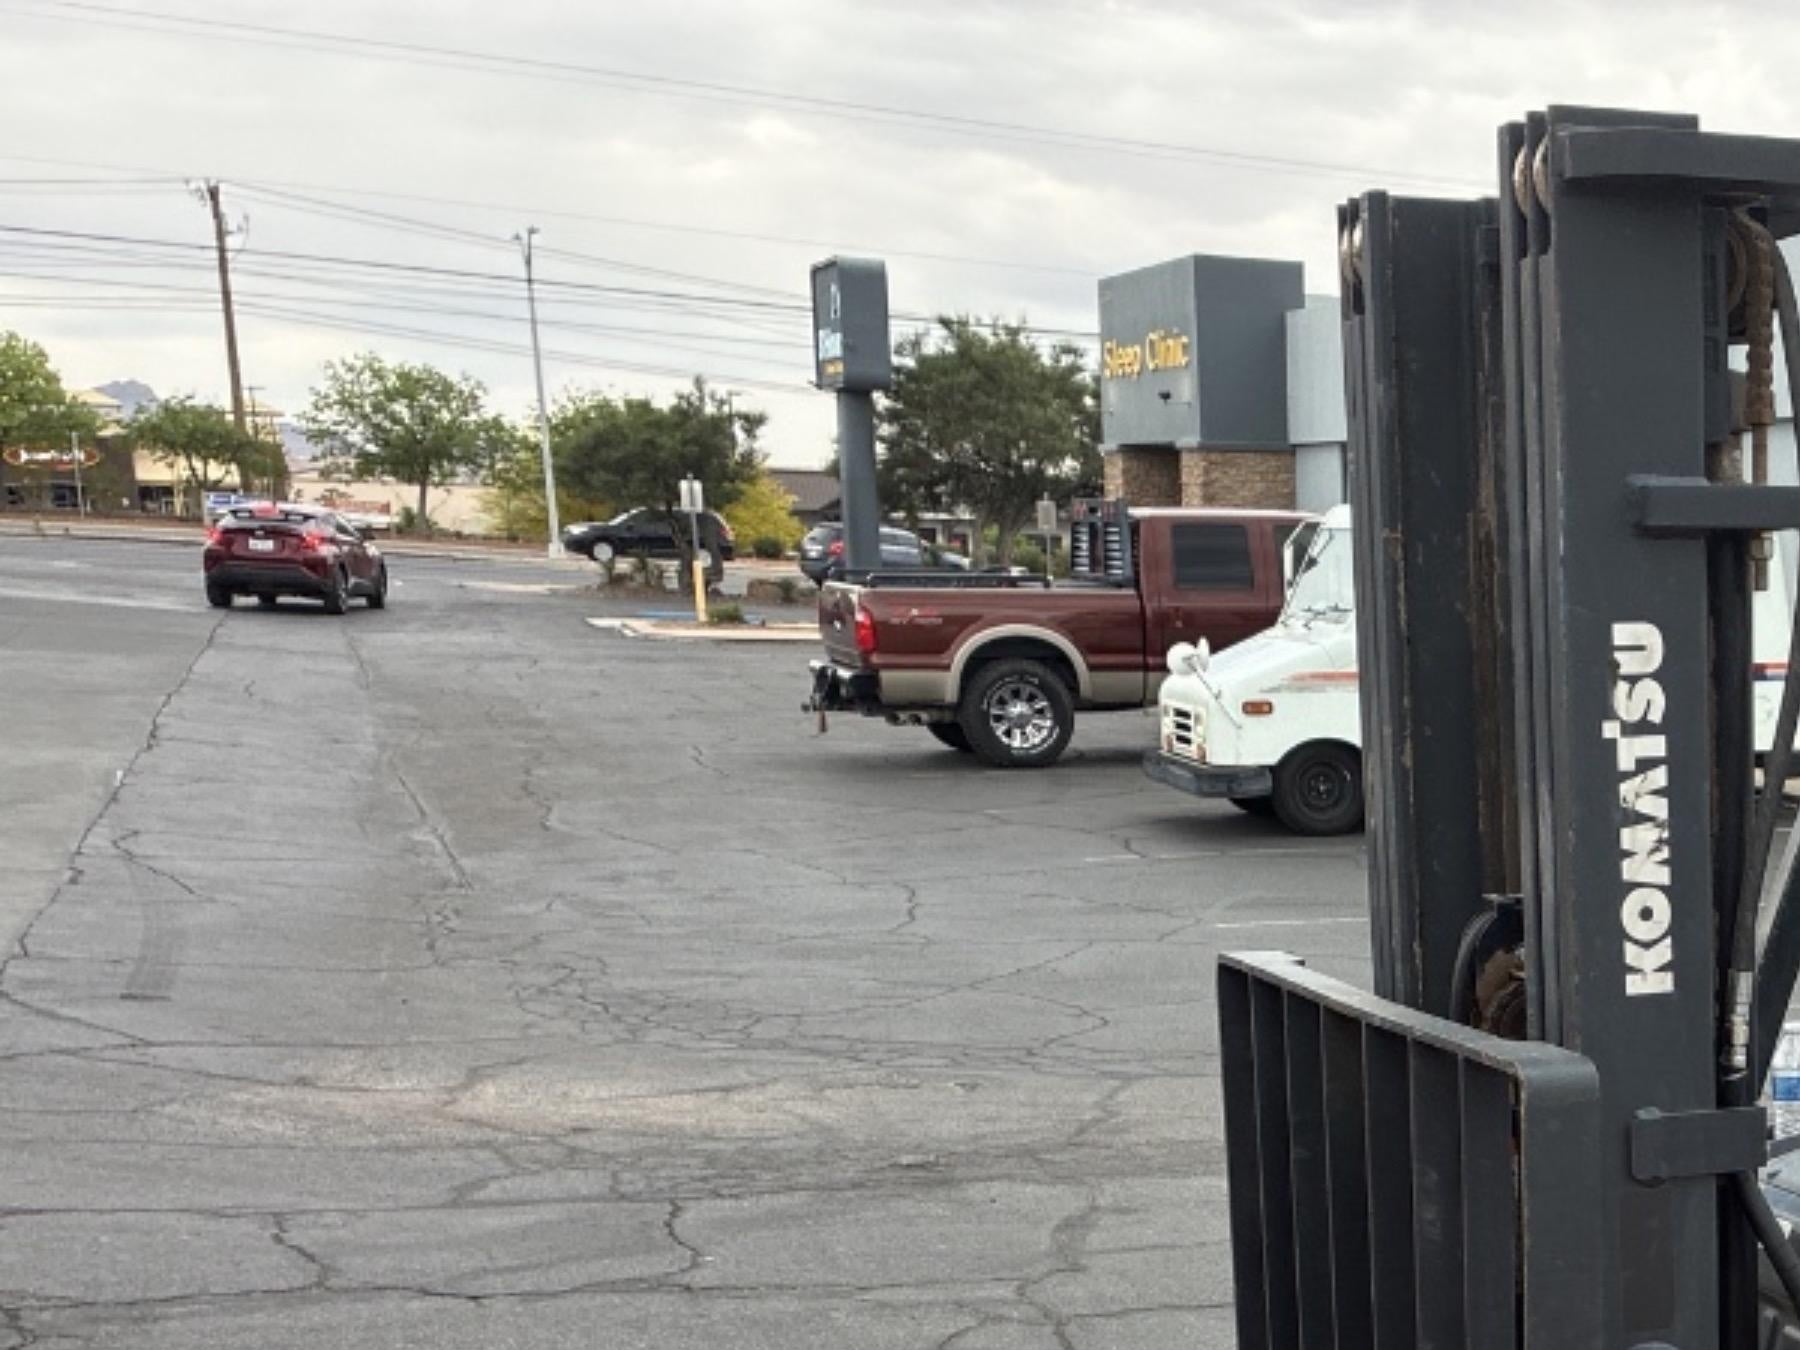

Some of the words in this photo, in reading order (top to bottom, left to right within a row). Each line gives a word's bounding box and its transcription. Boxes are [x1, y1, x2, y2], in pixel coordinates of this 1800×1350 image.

[1104, 339, 1142, 379] Sleep
[1146, 329, 1189, 370] Clinic
[1601, 620, 1675, 997] KOMATSU
